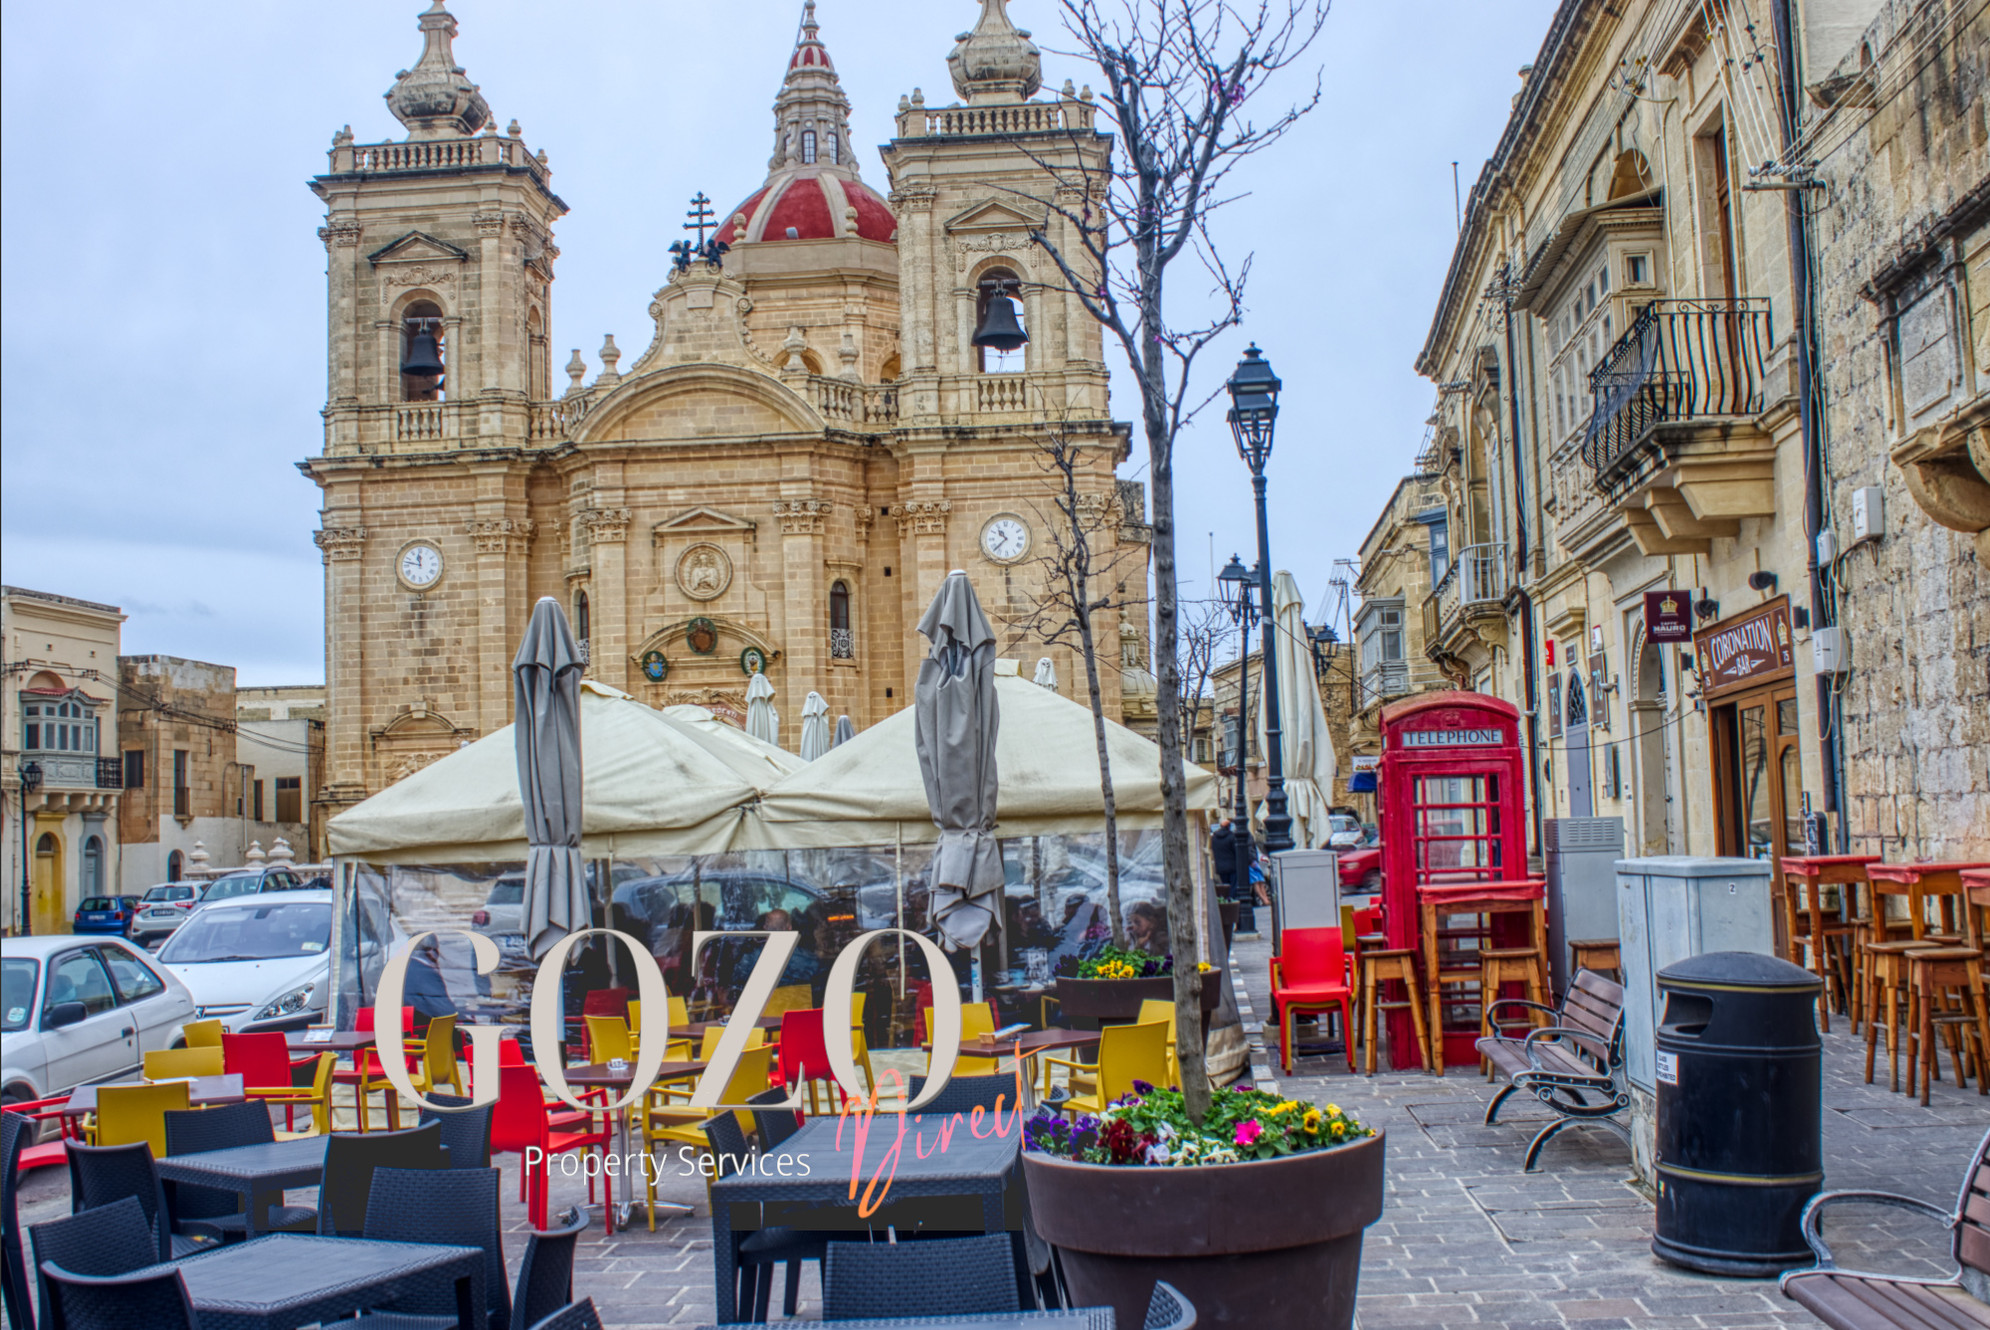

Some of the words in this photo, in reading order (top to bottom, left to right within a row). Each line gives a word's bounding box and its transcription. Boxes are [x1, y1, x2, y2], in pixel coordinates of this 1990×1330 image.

[1710, 617, 1774, 671] CORONATION
[1736, 654, 1751, 676] BAR
[1592, 669, 1603, 702] 73
[1550, 687, 1558, 716] 73
[1406, 729, 1499, 745] TELEPHONE
[1729, 884, 1735, 892] 2
